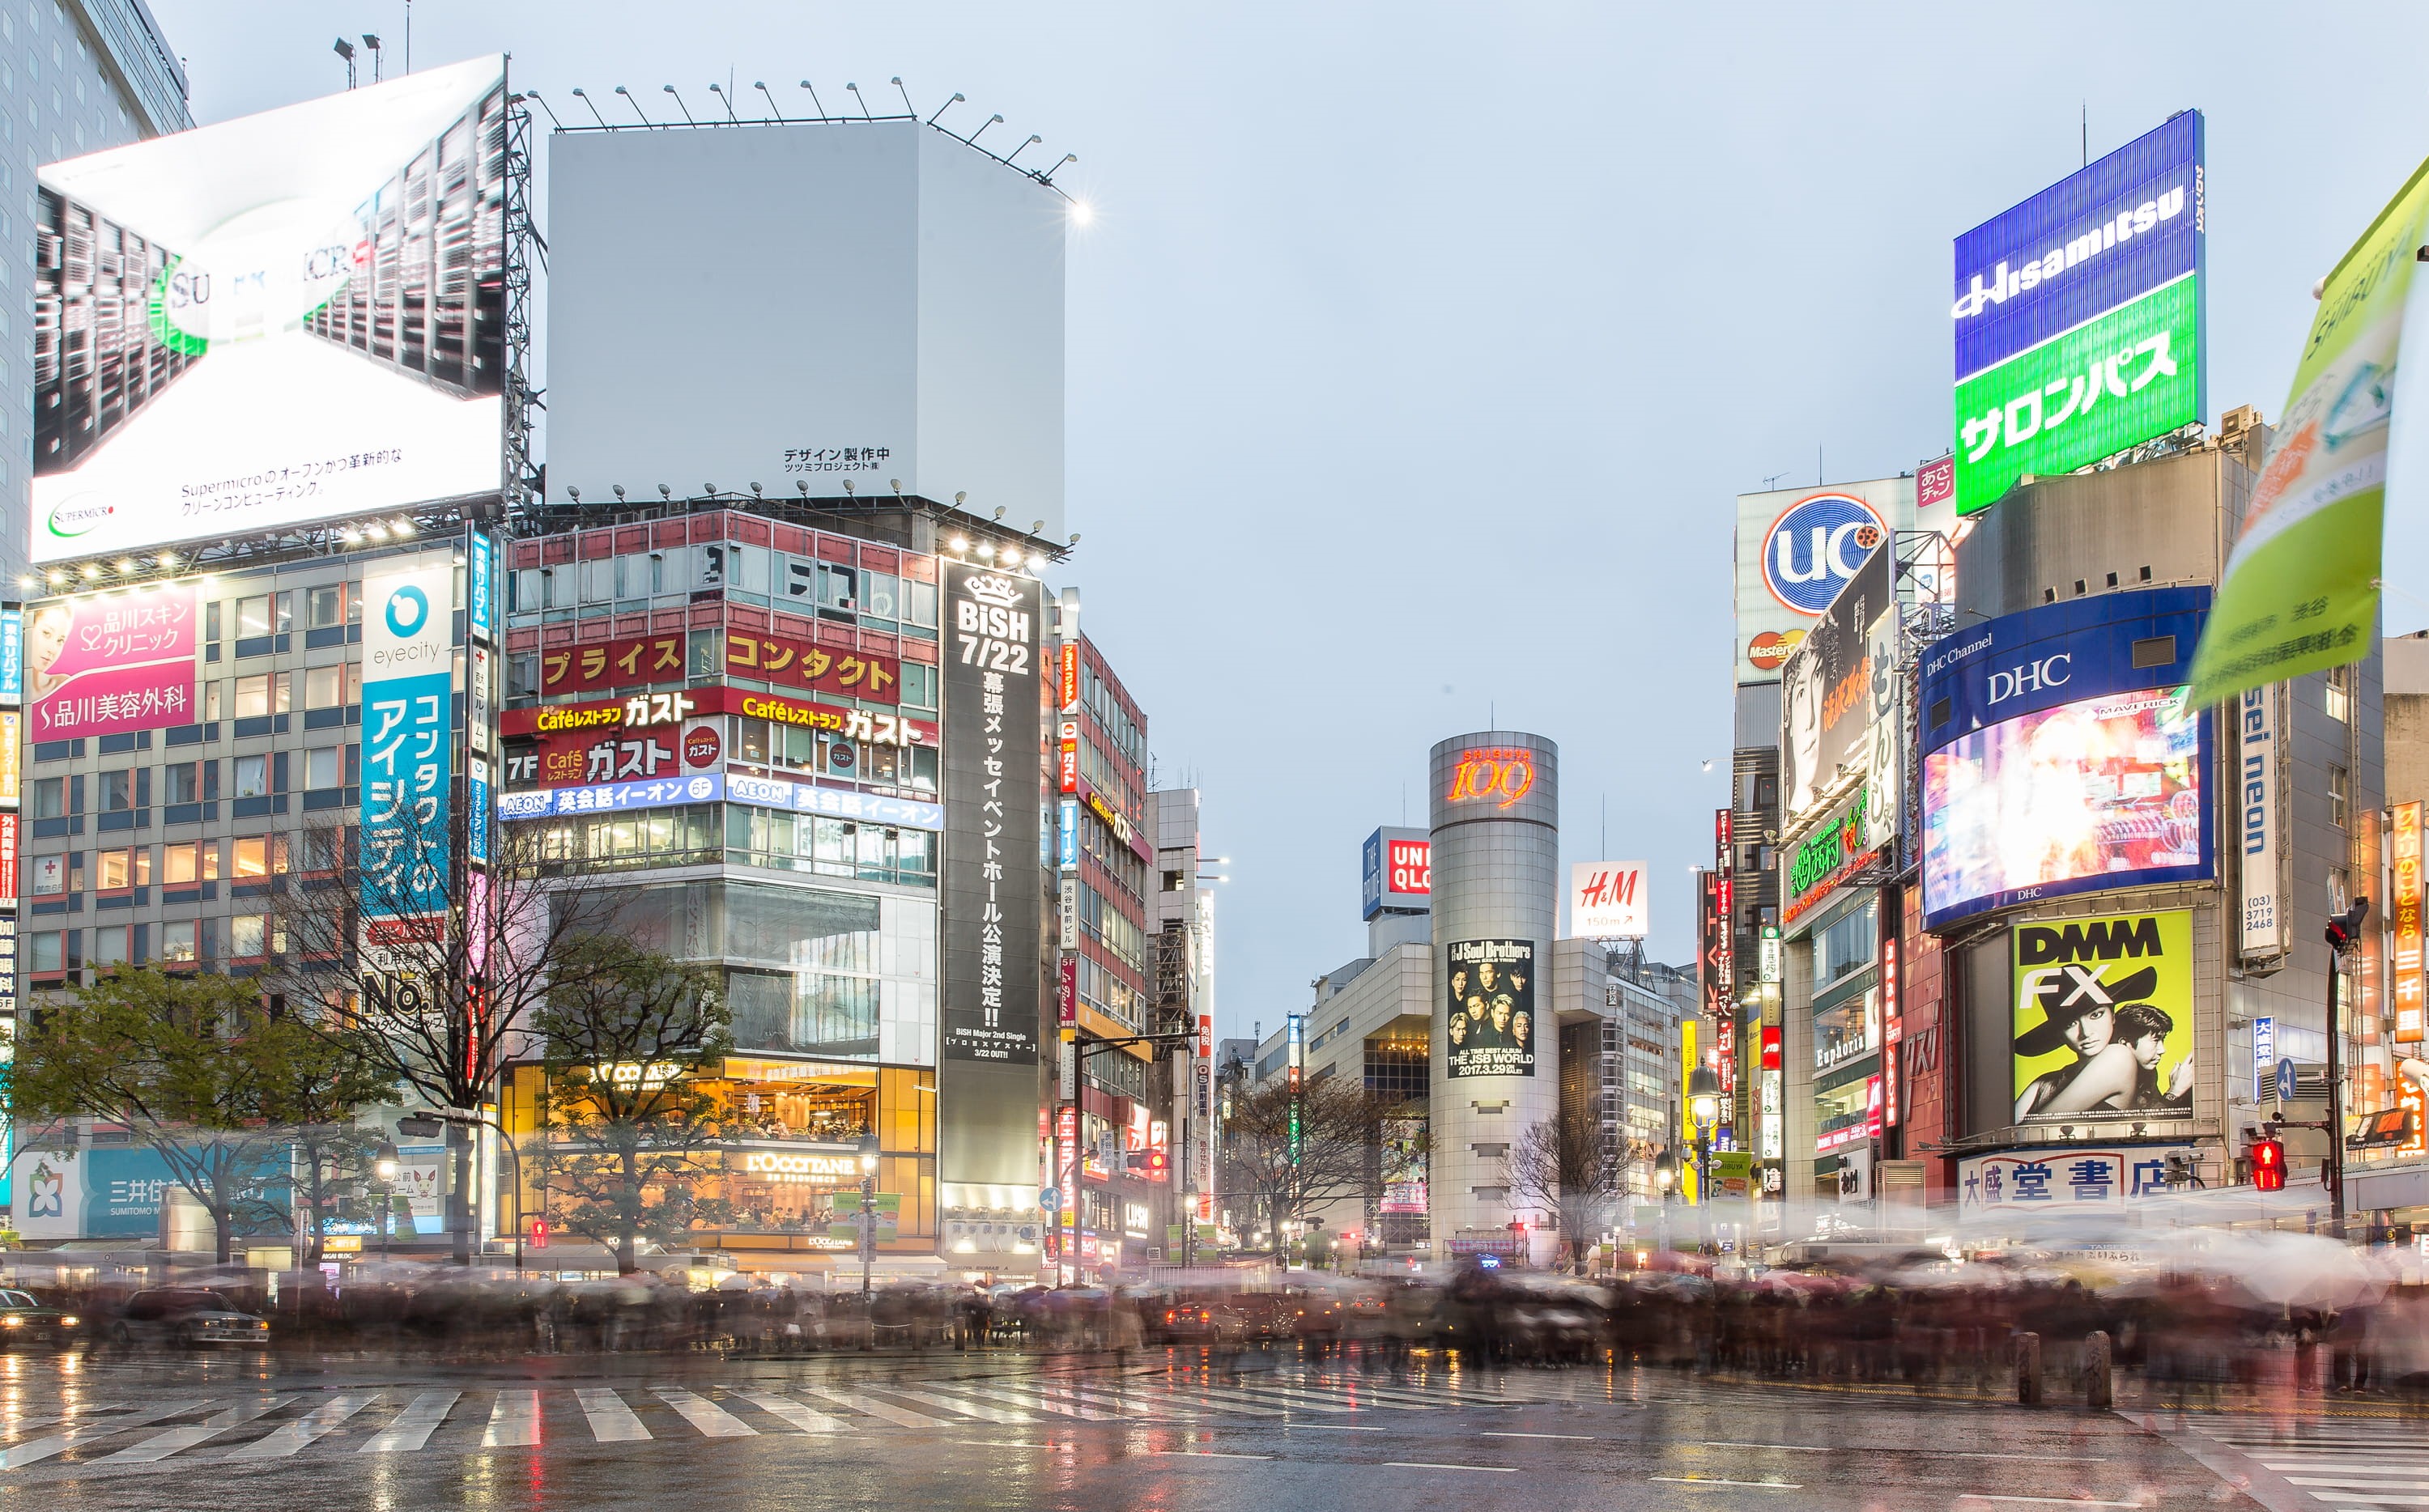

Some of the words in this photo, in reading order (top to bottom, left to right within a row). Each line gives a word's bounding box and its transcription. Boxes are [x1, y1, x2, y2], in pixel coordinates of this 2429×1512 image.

[2195, 164, 2205, 234] サロンパス
[1951, 185, 2184, 316] Hisamitsu
[1961, 330, 2177, 464] サロンパス
[784, 447, 890, 462] デザイン製作中
[1921, 464, 1950, 487] あさ
[103, 602, 189, 632] 品川スキン
[959, 600, 1029, 643] BiSH
[3, 623, 17, 690] 東急リバブル
[104, 628, 179, 657] クリニック
[374, 641, 440, 668] eyecity
[959, 634, 1029, 676] 7/22
[1926, 655, 1946, 678] DHC
[1947, 633, 1993, 663] Channel
[544, 639, 682, 685] プライス
[729, 635, 894, 690] コンタクト
[1988, 652, 2071, 705] DHC
[54, 685, 186, 728] 品川美容外科
[625, 691, 694, 727] ガスト
[844, 708, 924, 748] ガスト
[508, 755, 538, 780] 7F
[547, 750, 583, 770] Café
[586, 738, 671, 783] ガスト
[689, 745, 717, 758] ガスト
[1464, 749, 1532, 761] SHIBUYA
[547, 768, 581, 782] レストラン
[1063, 752, 1074, 786] ガスト
[1448, 759, 1534, 809] 109
[371, 699, 406, 895] アイシティ
[413, 695, 439, 893] コンタクトの
[505, 796, 544, 815] AEON
[558, 783, 683, 810] 英会話イーオン
[691, 781, 708, 795] 6F
[734, 780, 784, 802] AEON
[798, 788, 939, 824] 英会話イーオン
[2244, 754, 2265, 856] neon
[1811, 832, 1840, 882] 西村
[1581, 869, 1639, 908] H&M
[2398, 809, 2417, 940] クスリのことなら
[2018, 887, 2042, 900] DHC
[2248, 894, 2270, 909] (03)
[1064, 886, 1073, 943] 渋谷駅前ビル
[1587, 916, 1620, 927] 150m
[2246, 907, 2273, 921] 3719
[2246, 919, 2274, 931] 2468
[1457, 943, 1463, 961] J
[1464, 941, 1485, 960] Soul
[1486, 941, 1530, 959] Brothers
[2018, 917, 2163, 966] DMM
[1062, 958, 1075, 966] 5F
[364, 969, 445, 1017] No.1
[2018, 964, 2113, 1009] FX
[2397, 949, 2422, 1031] 三千里
[956, 1028, 972, 1036] BiSH
[972, 1029, 992, 1038] Major
[993, 1031, 1005, 1039] 2nd
[1006, 1032, 1026, 1042] Single
[1201, 1026, 1210, 1046] 免税
[1817, 1033, 1864, 1067] Euphoria
[974, 1049, 989, 1057] 3/22
[1448, 1055, 1468, 1066] THE
[1469, 1054, 1491, 1064] JSB
[1493, 1054, 1534, 1064] WORLD
[1459, 1064, 1505, 1076] 2017.3.29
[1198, 1065, 1208, 1084] OS
[1198, 1085, 1207, 1117] 調剤薬局
[747, 1153, 855, 1174] L'OCCITANE
[1104, 1133, 1112, 1166] 渋谷駅前
[1199, 1140, 1207, 1182] 処方せん受付
[110, 1207, 153, 1216] SUMITOMO
[1125, 1203, 1148, 1230] LUSH
